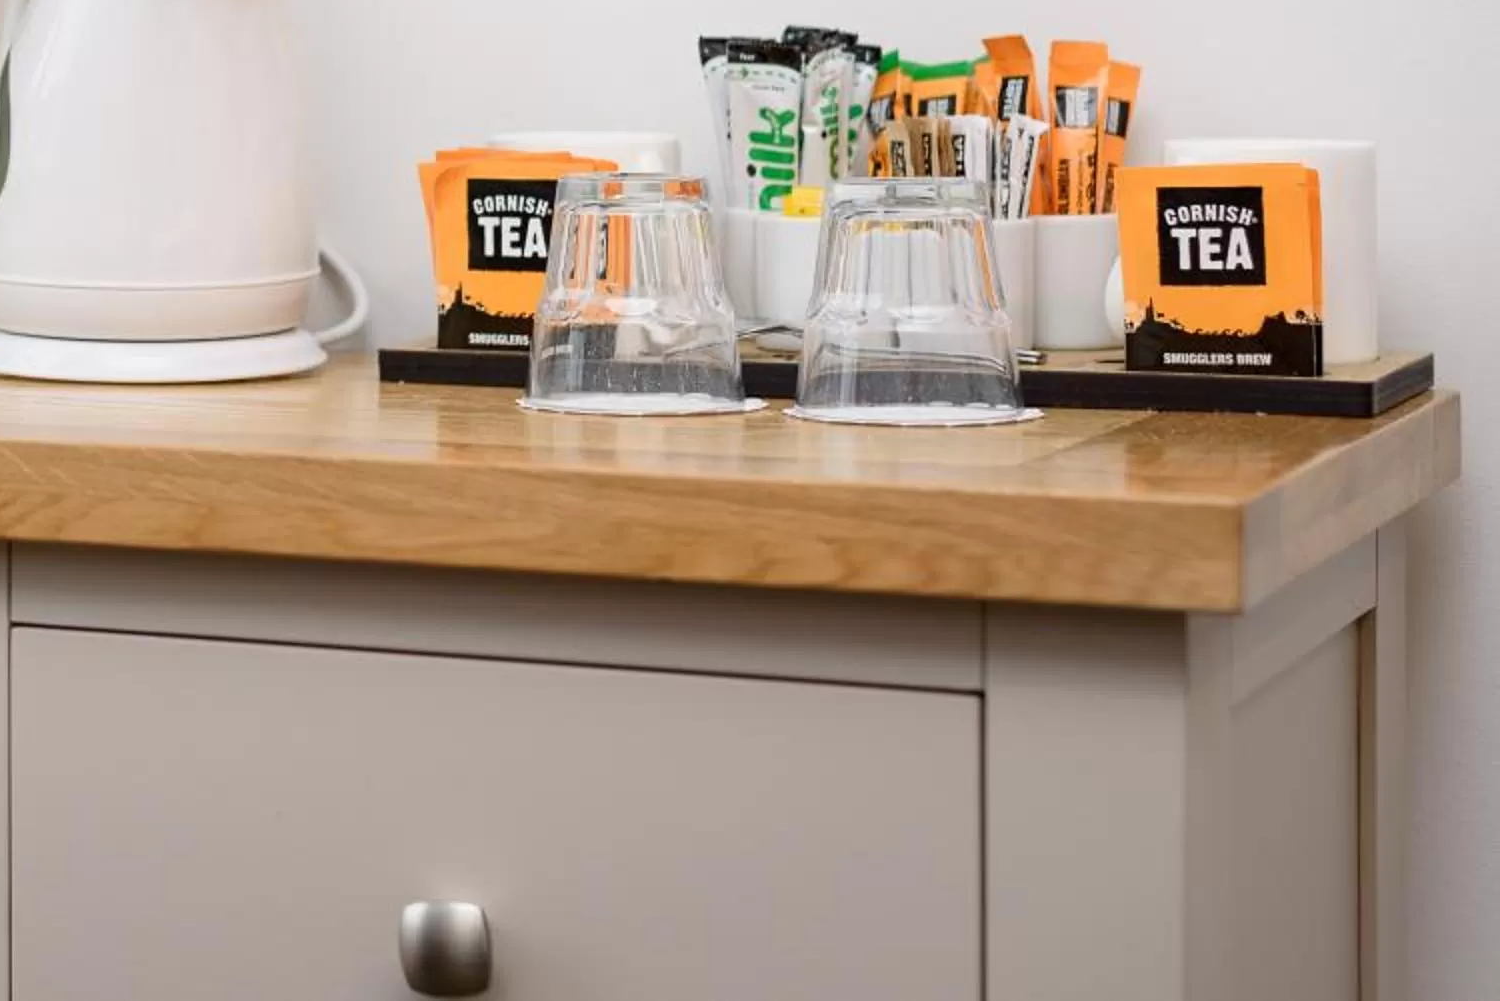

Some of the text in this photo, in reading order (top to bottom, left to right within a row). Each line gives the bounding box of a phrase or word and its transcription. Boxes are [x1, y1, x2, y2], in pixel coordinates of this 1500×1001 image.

[472, 194, 549, 217] CORNISH
[1164, 203, 1253, 226] CORNISH
[477, 216, 547, 258] TEA
[1170, 226, 1254, 270] TEA
[468, 332, 529, 346] SMUGGLERS
[1163, 352, 1273, 366] SMUGGLERS BREW
